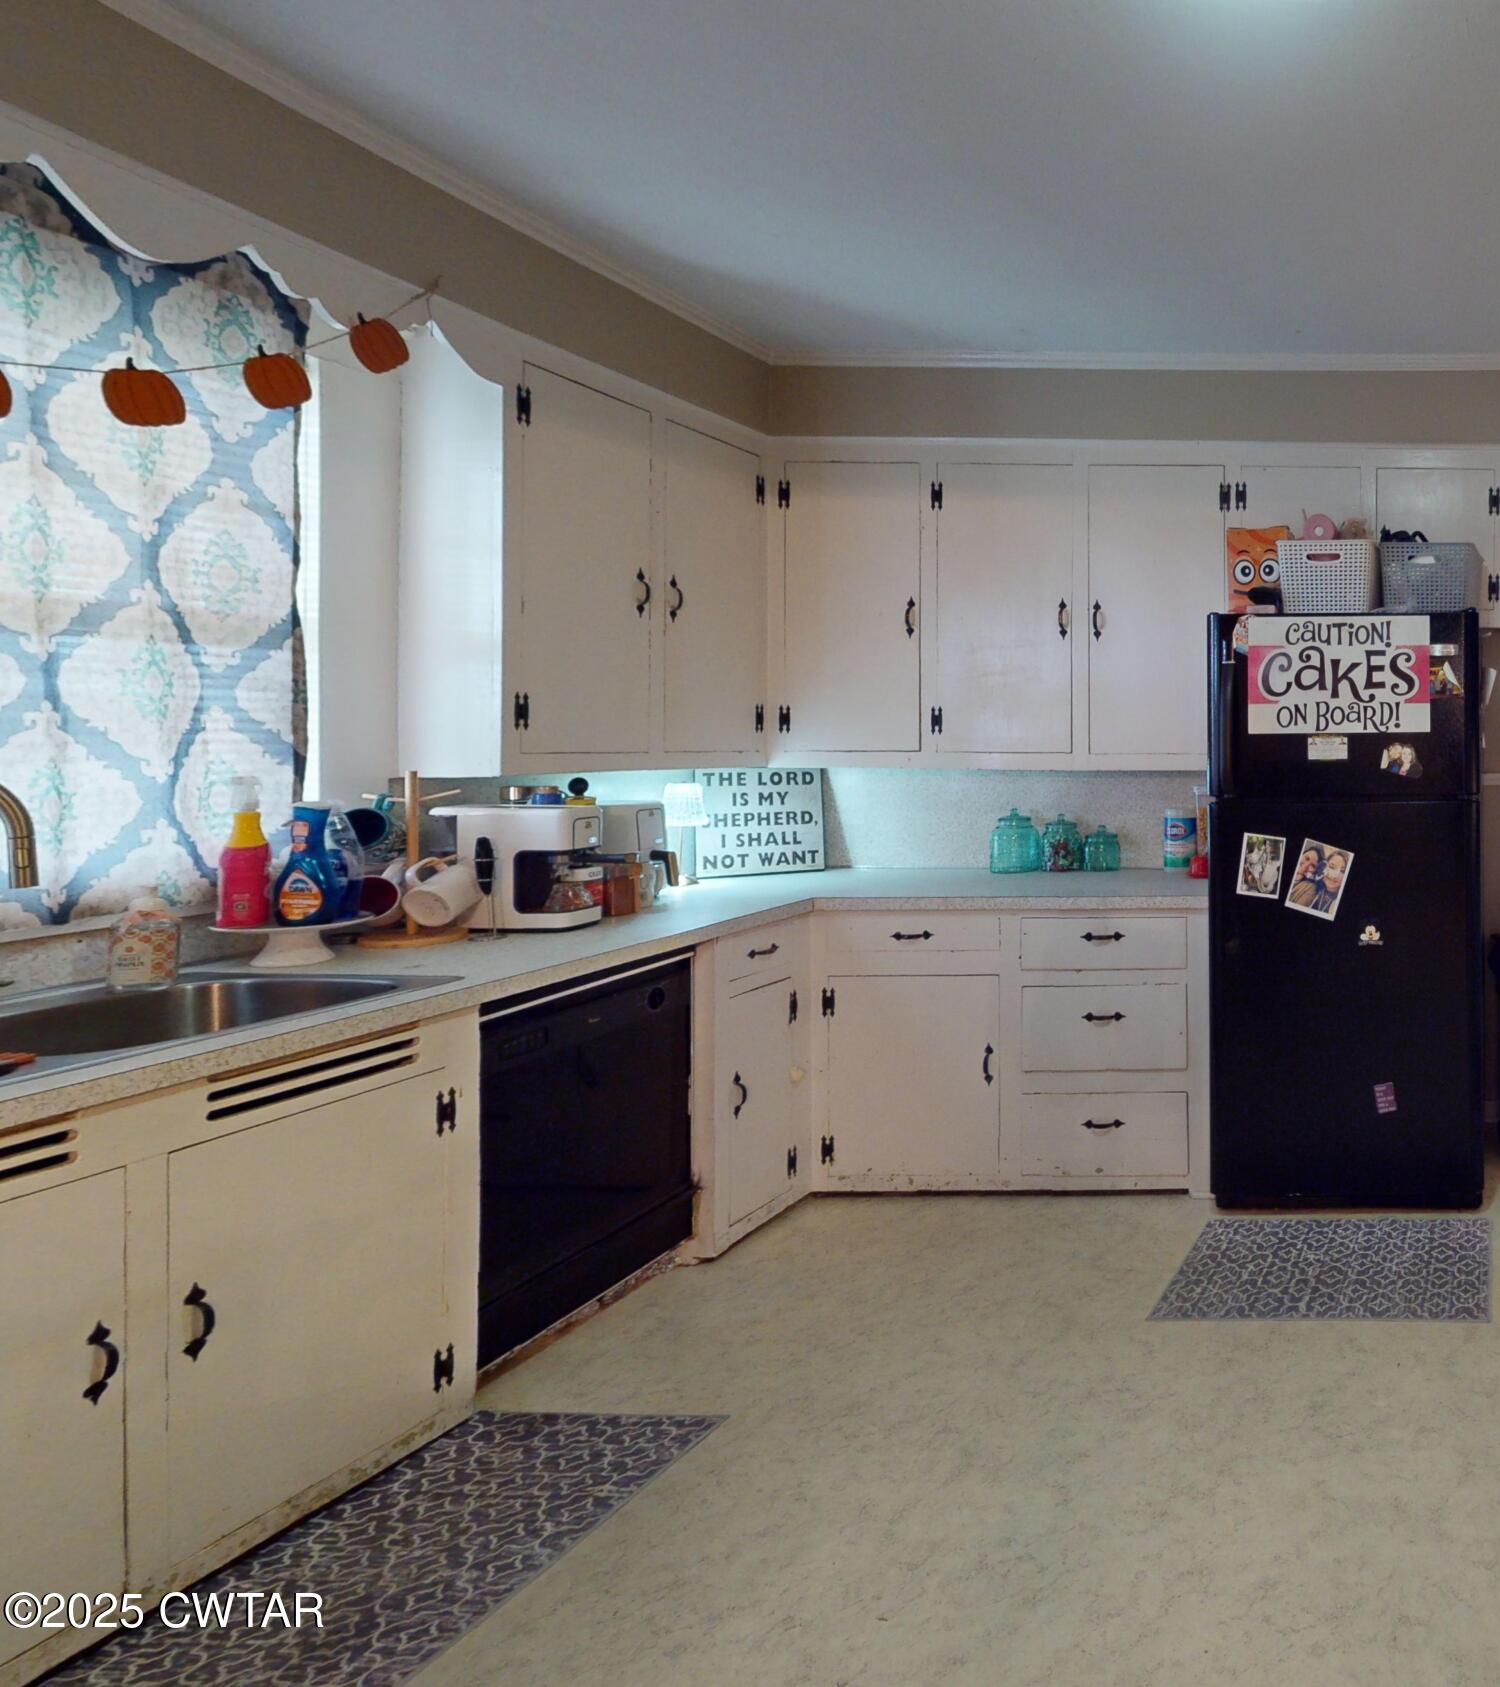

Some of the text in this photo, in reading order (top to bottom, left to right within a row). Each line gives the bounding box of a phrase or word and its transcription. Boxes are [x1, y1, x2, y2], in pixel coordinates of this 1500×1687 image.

[1277, 703, 1307, 728] ON
[702, 771, 815, 787] THE LORD
[732, 791, 789, 807] IS MY
[721, 831, 802, 848] I SHALL
[703, 850, 819, 870] NOT WANT
